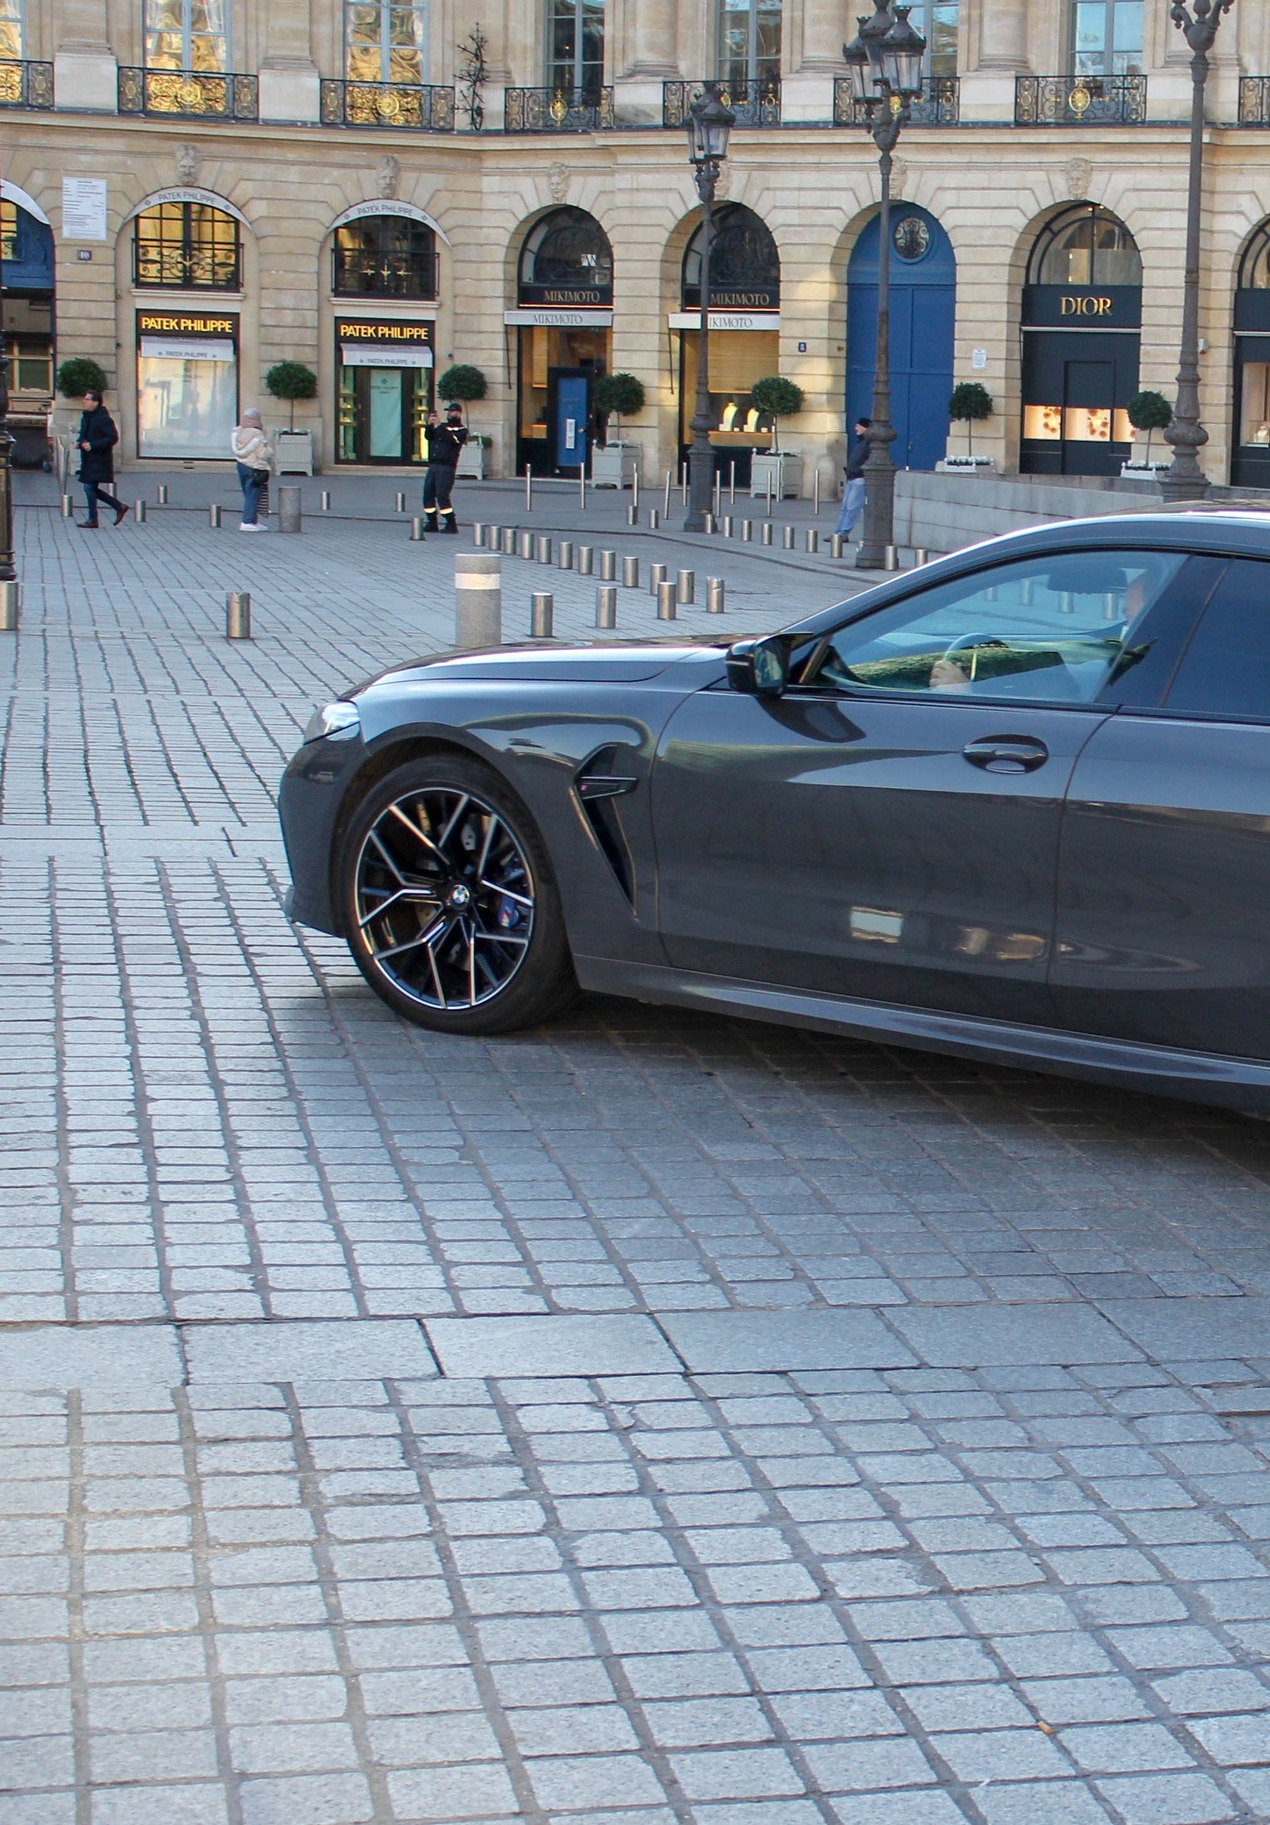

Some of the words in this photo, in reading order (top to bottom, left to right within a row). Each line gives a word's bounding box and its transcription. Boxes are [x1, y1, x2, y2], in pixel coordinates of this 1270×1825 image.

[158, 191, 182, 202] PATEK
[183, 191, 217, 205] PHILIPPE
[357, 205, 381, 215] PATEK
[381, 204, 414, 217] PHILIPPE
[544, 290, 600, 303] MIKIMOTO
[710, 293, 770, 306] MIKIMOTO
[1060, 296, 1113, 316] DIOR
[141, 317, 179, 330] PATEK
[181, 318, 233, 333] PHILIPPE
[533, 313, 583, 325] MIKIMOTO
[709, 316, 753, 329] IKIMOTO
[340, 324, 377, 338] PATEK
[378, 326, 429, 340] PHILIPPE
